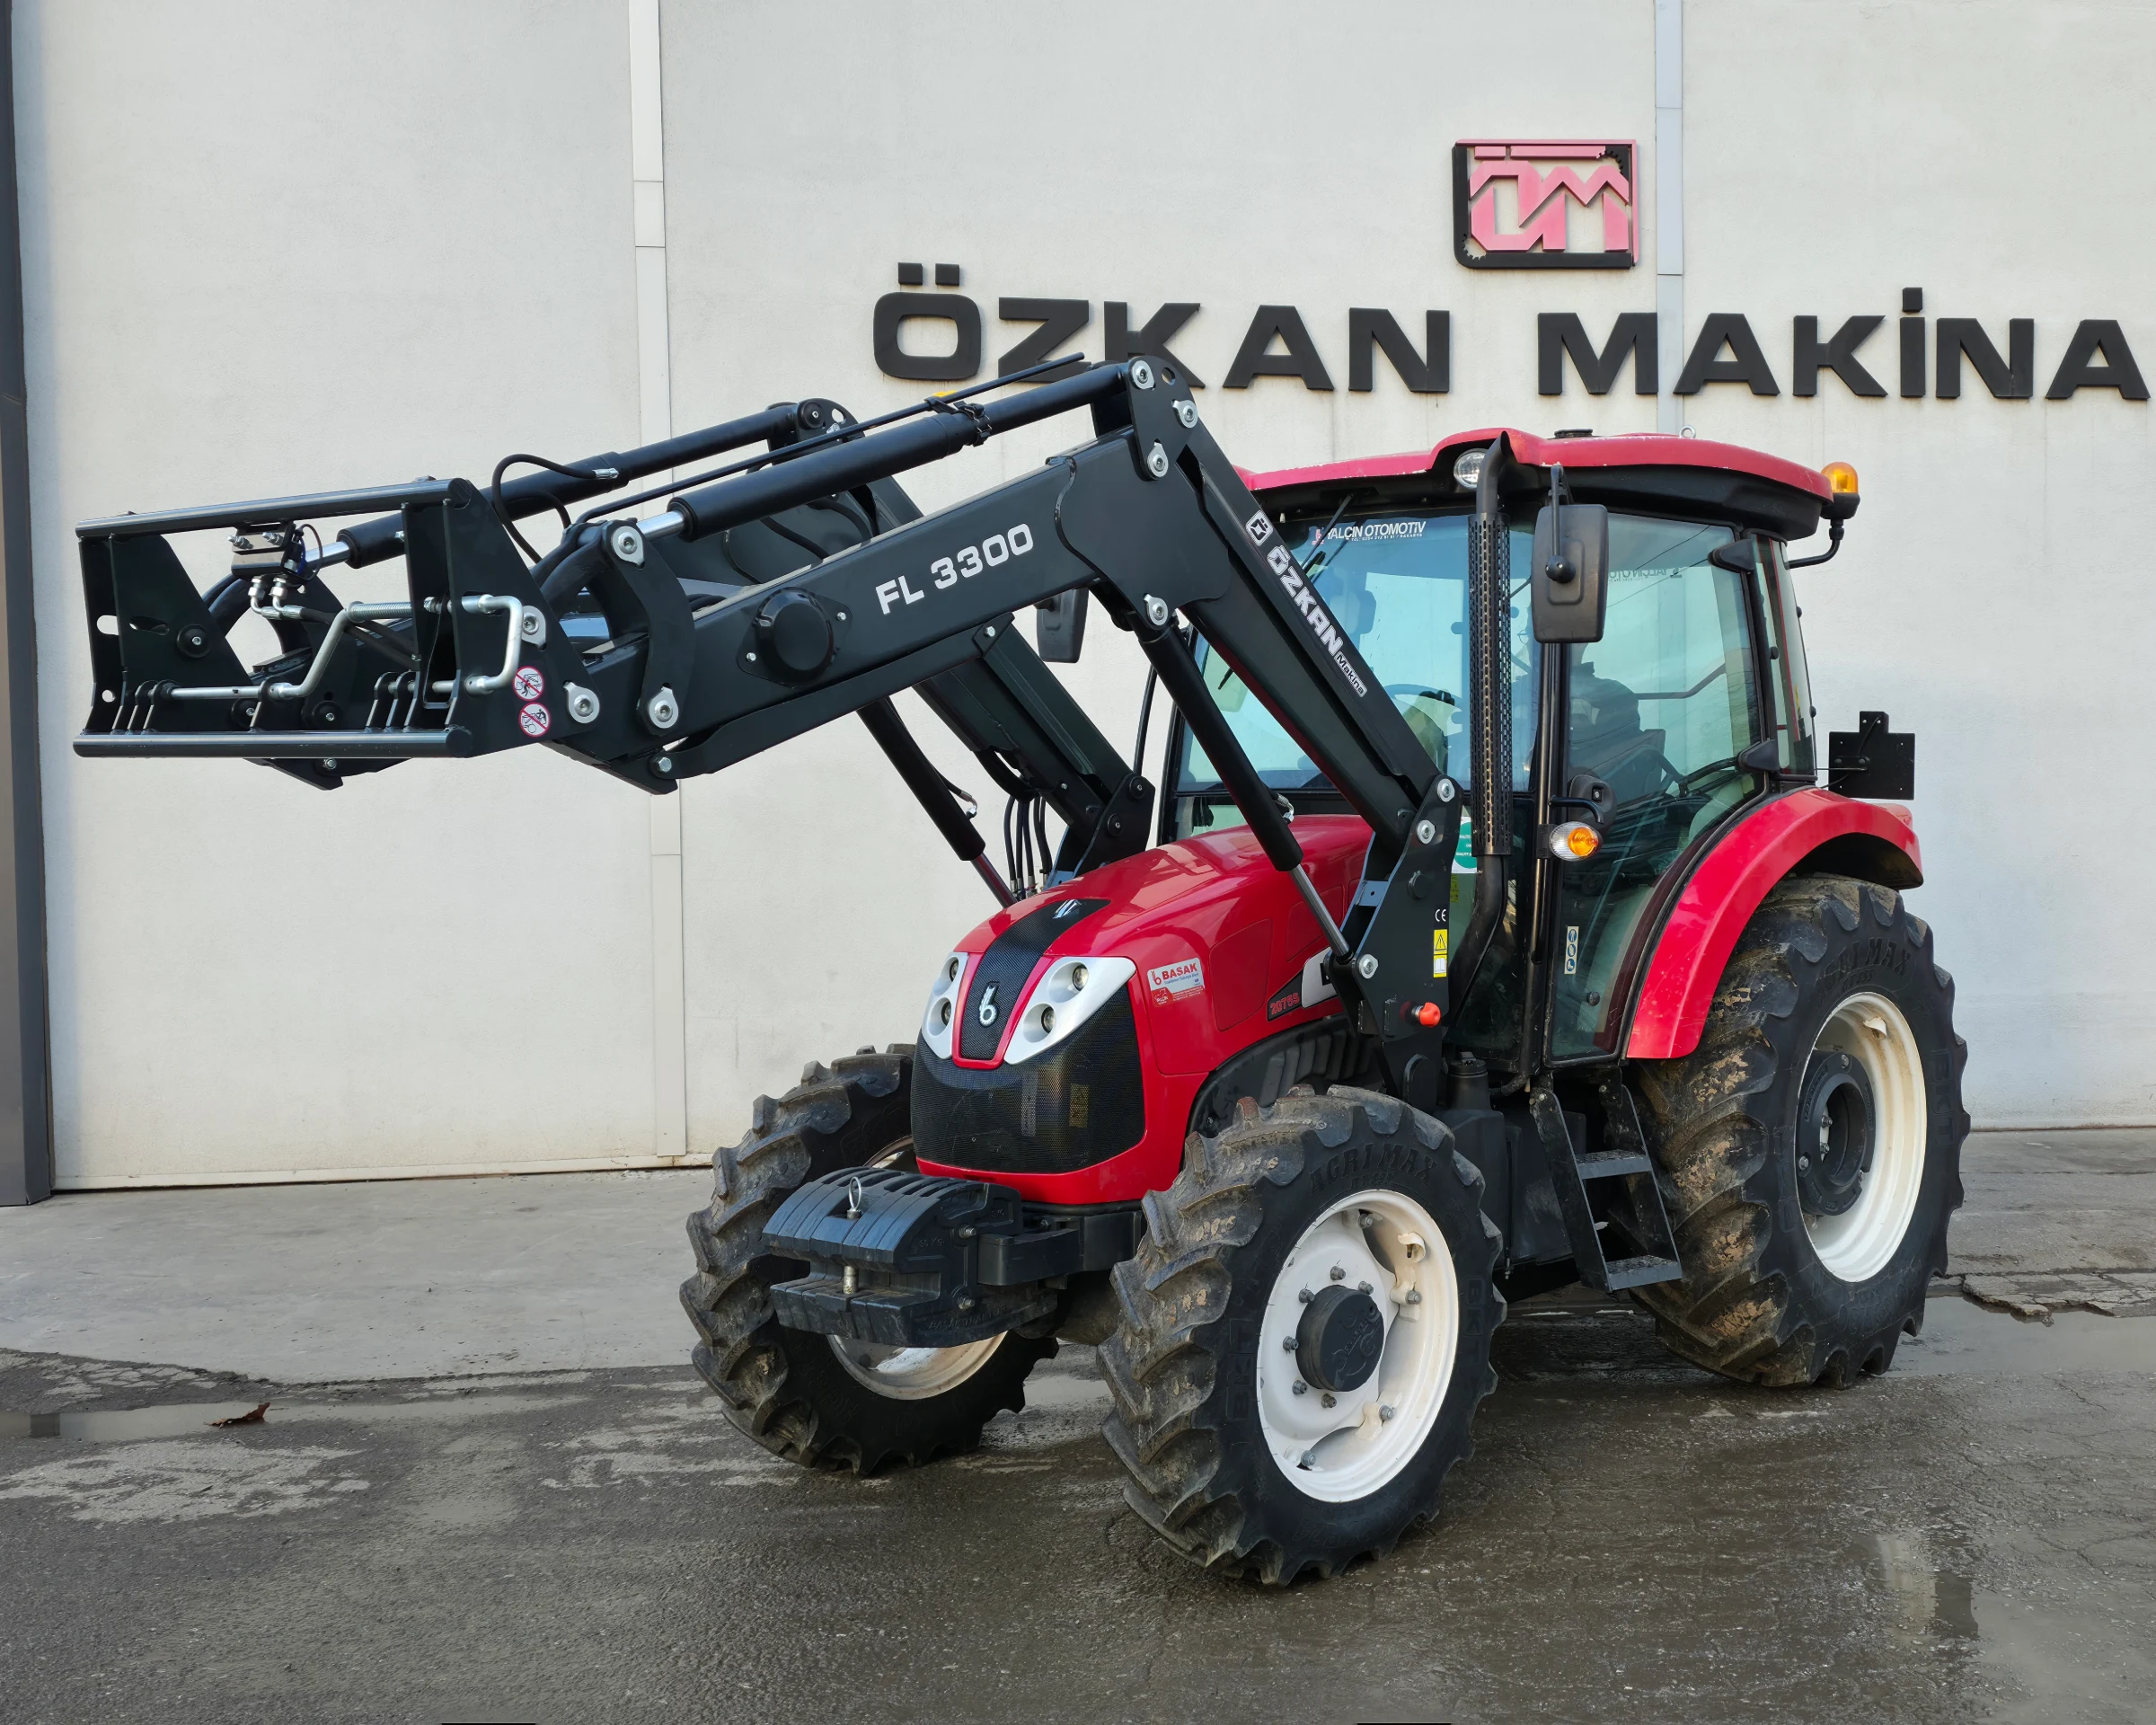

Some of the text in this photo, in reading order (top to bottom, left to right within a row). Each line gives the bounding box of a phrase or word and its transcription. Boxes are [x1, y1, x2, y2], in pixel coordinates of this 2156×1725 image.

[872, 261, 2152, 400] ÖZKAN MAKİNA
[875, 523, 1034, 615] FL 3300
[1267, 544, 1365, 696] ÖZKAN Makina
[1162, 963, 1198, 980] BASAK
[1269, 993, 1301, 1015] 2075S
